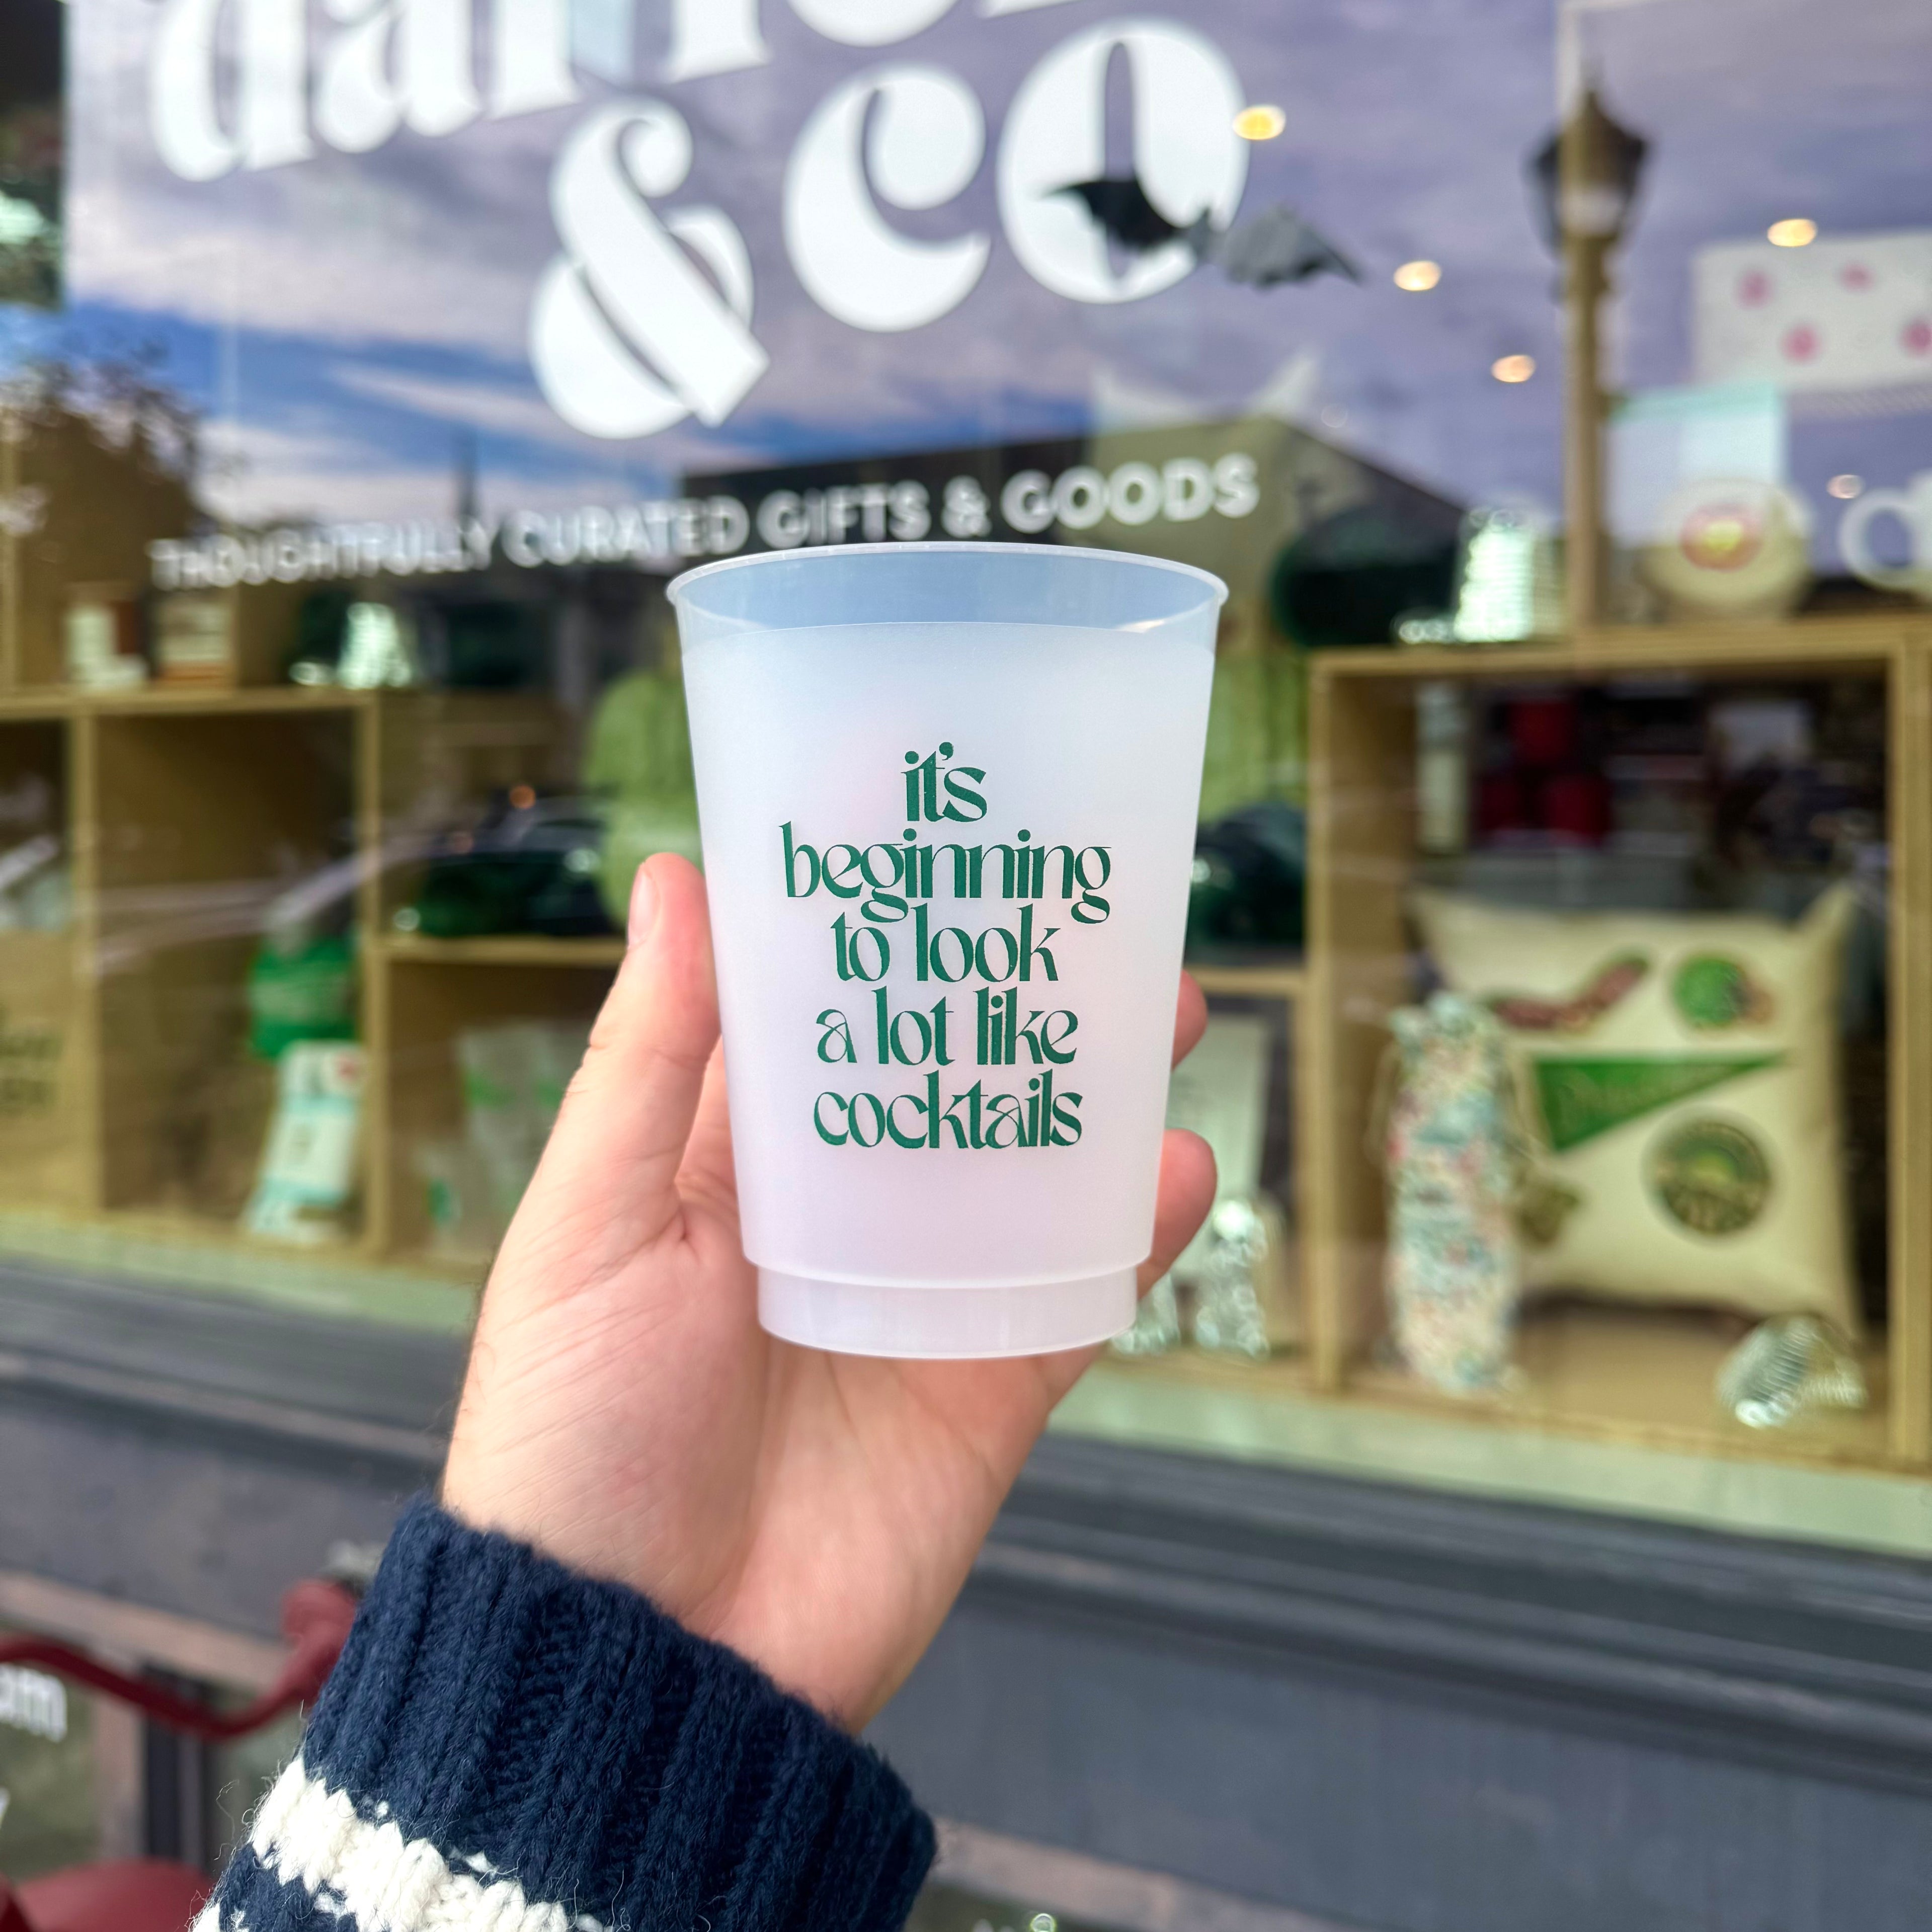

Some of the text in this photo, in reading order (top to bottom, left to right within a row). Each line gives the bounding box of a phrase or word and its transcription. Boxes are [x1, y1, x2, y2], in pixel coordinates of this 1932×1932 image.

[502, 495, 751, 568] CURATED
[756, 480, 932, 549] GIFTS
[941, 474, 992, 539] &
[1001, 452, 1261, 534] GOODS
[901, 742, 987, 823] it's
[778, 821, 1112, 924] beginning
[830, 903, 1061, 983] to look
[816, 985, 1079, 1066] a lot like
[813, 1069, 1083, 1150] cocktails
